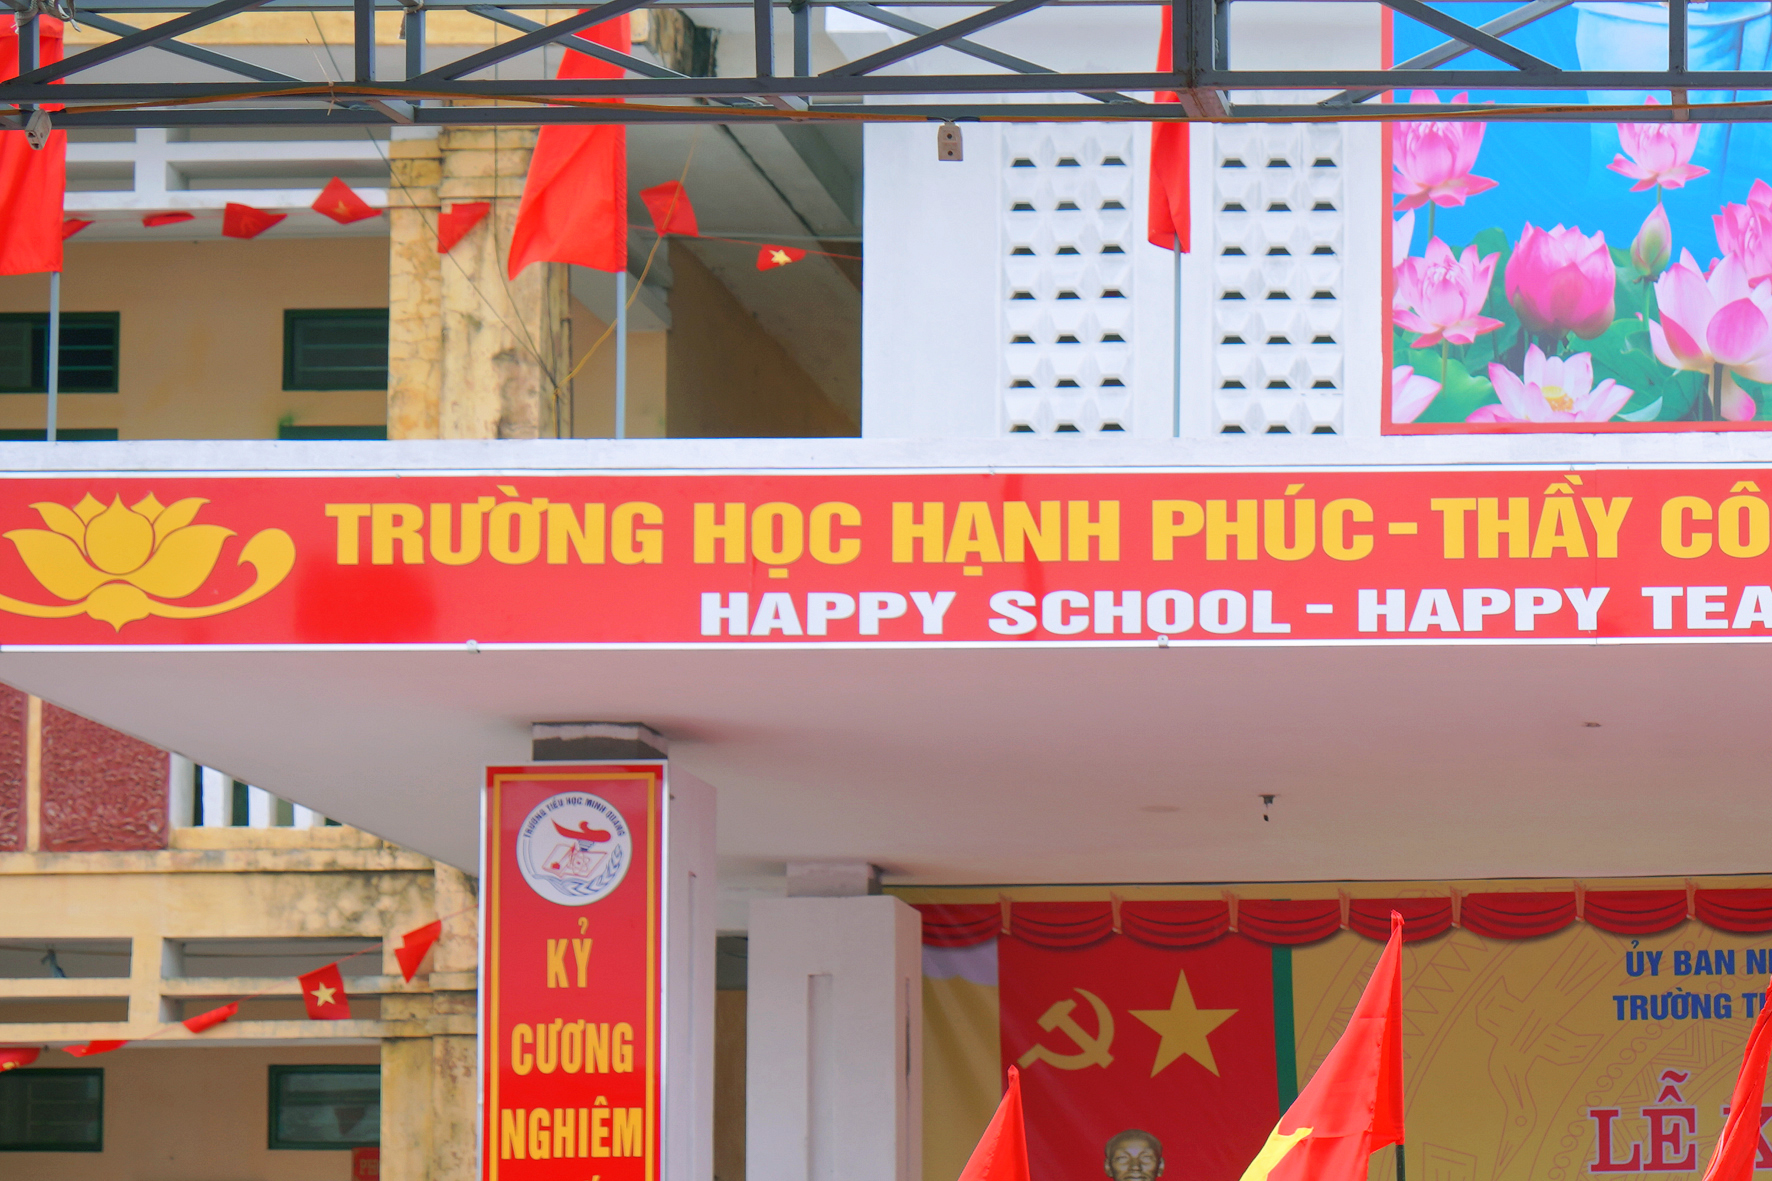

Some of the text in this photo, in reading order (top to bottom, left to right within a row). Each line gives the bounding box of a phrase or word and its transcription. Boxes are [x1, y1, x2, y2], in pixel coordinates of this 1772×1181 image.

[325, 486, 663, 566] TRƯỜNG
[694, 502, 861, 579] HỌC
[893, 500, 1120, 577] HẠNH
[1153, 483, 1374, 562] PHÚC
[1431, 474, 1631, 559] THẦY
[1662, 481, 1771, 558] CÔ
[700, 589, 956, 636] HAPPY
[989, 588, 1290, 636] SCHOOL
[1358, 586, 1610, 633] HAPPY
[585, 798, 606, 813] MINH
[605, 811, 626, 837] QUANG
[546, 917, 593, 988] KỶ
[1626, 940, 1663, 977] ỦY
[1674, 950, 1735, 976] BAN
[1613, 987, 1732, 1021] TRƯỜNG
[511, 1018, 634, 1076] CƯƠNG
[501, 1095, 643, 1160] NGHIÊM
[1590, 1070, 1696, 1172] LỄ
